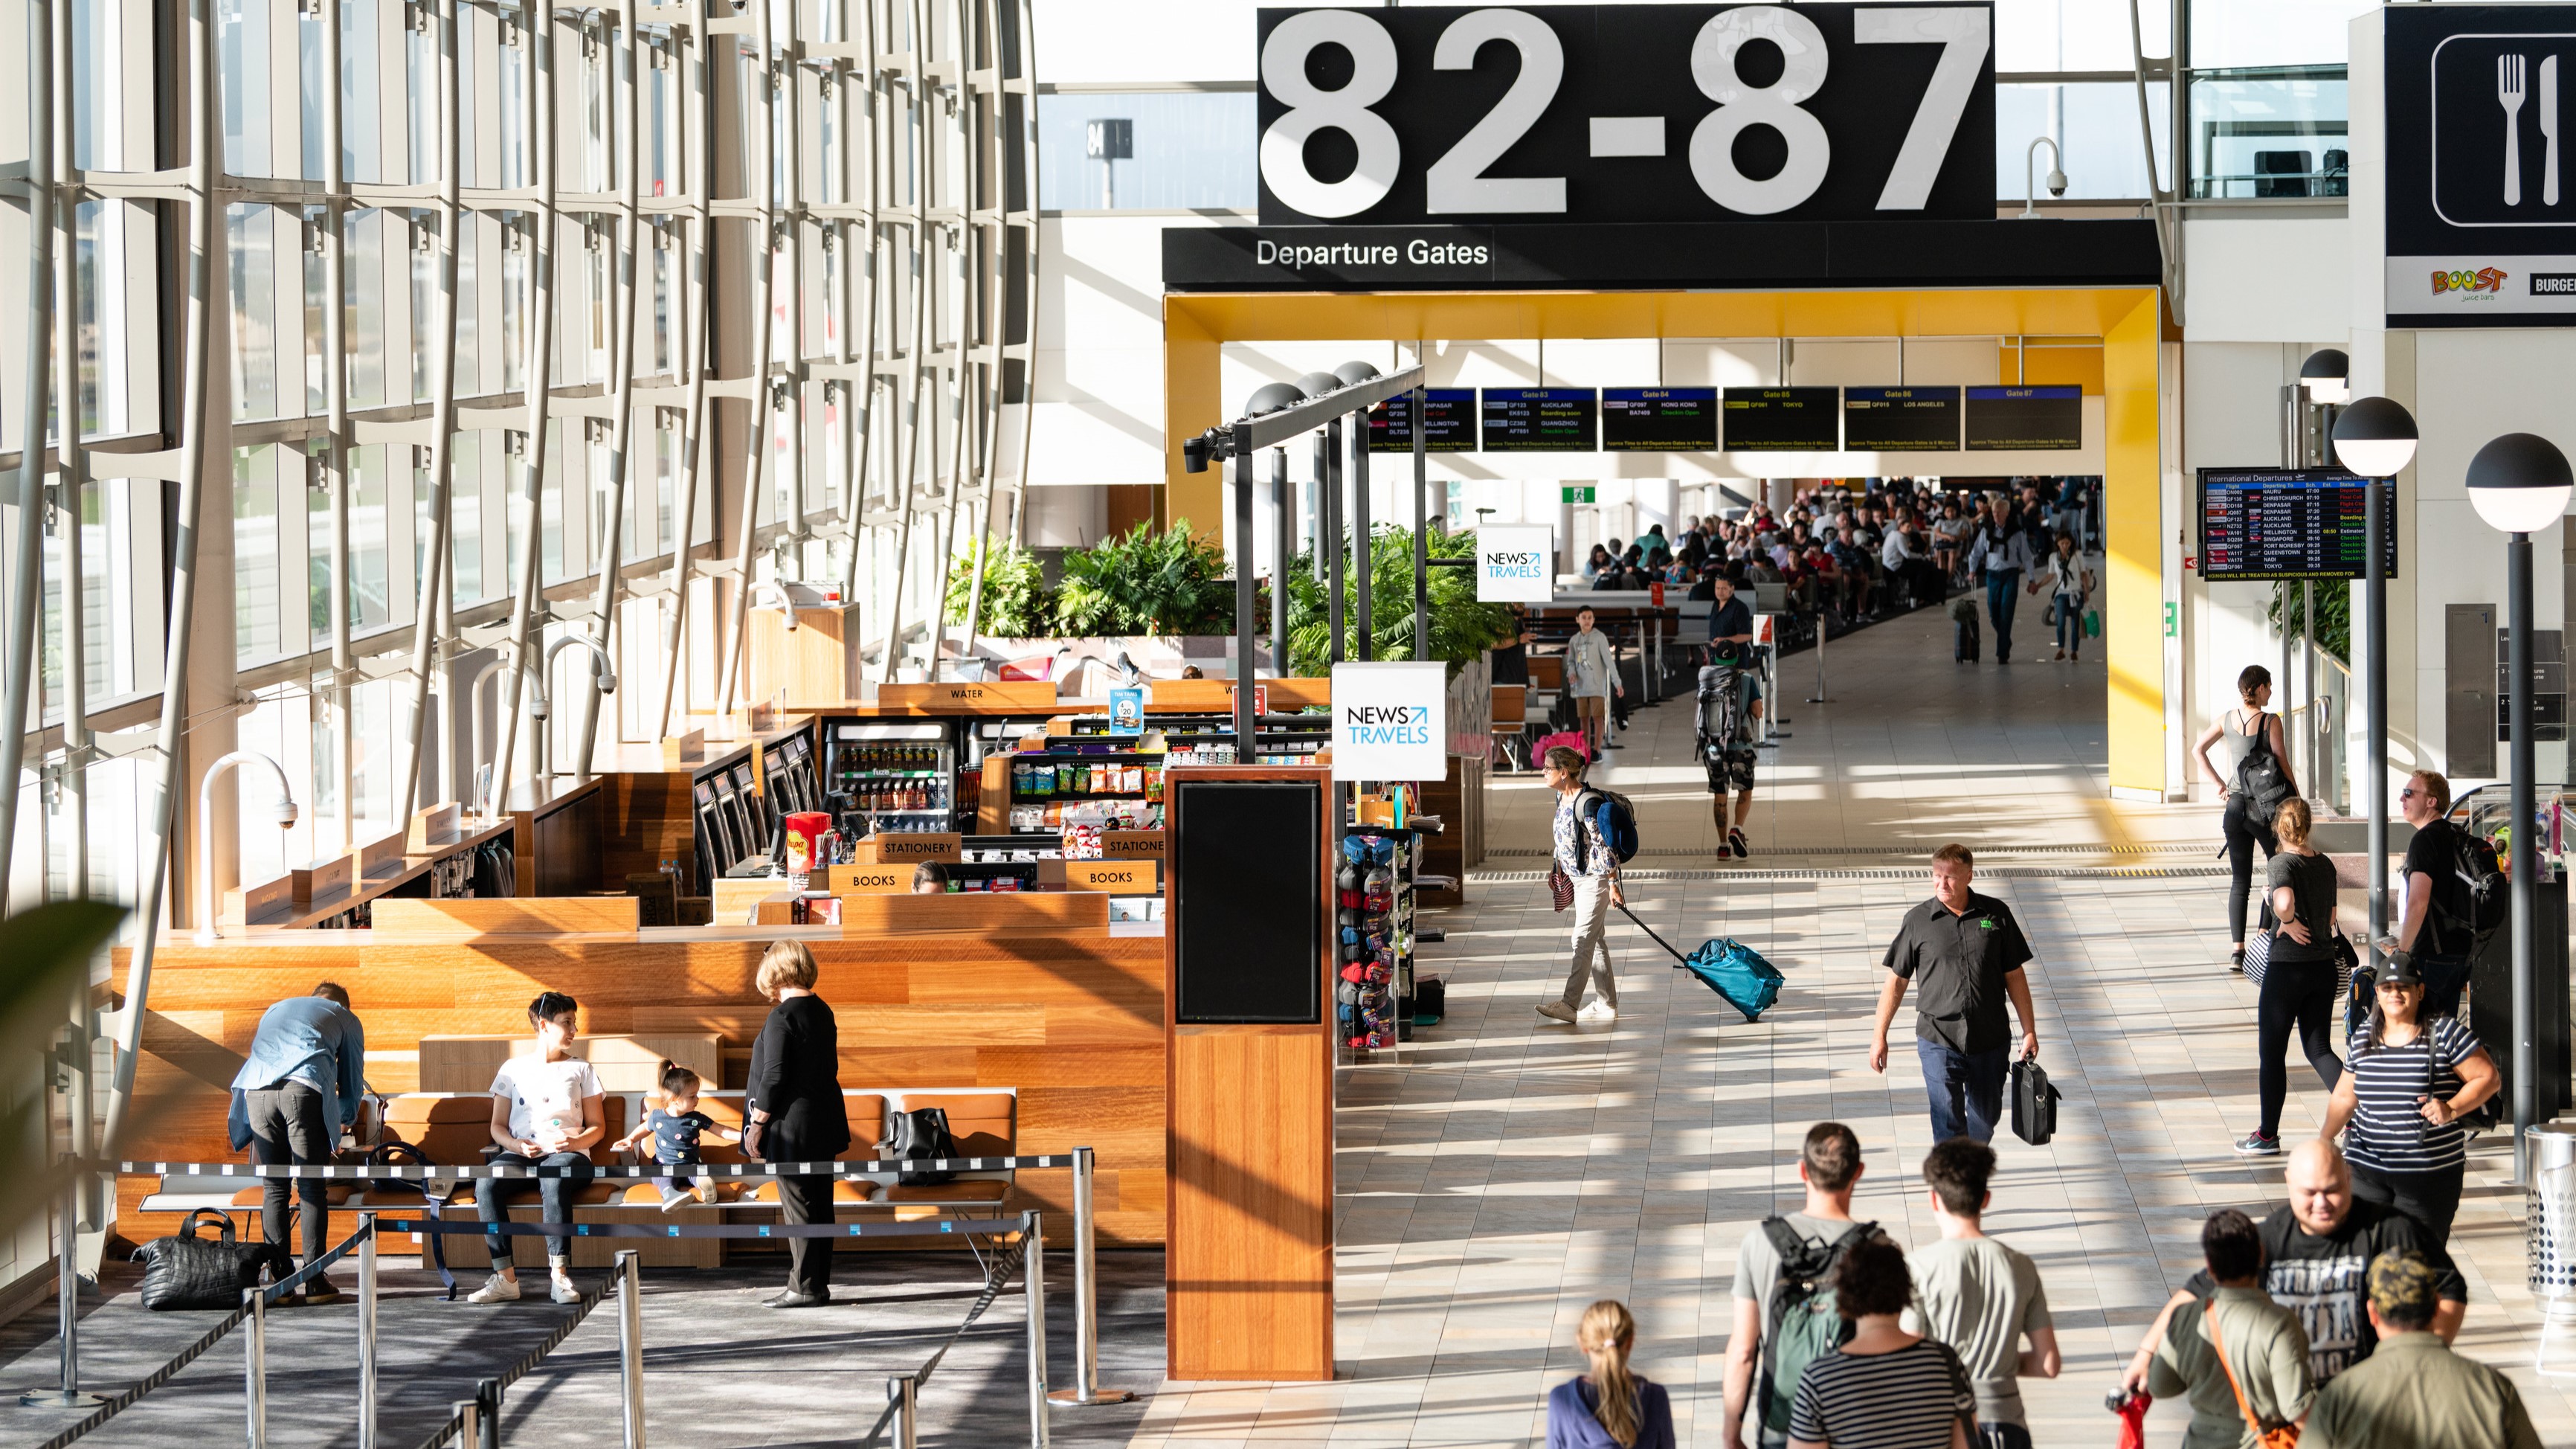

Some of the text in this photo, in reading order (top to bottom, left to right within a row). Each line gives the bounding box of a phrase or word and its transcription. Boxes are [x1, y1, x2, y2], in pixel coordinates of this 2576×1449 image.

[1260, 6, 1990, 218] 82-87
[1258, 240, 1488, 270] Departure Gates
[2432, 267, 2508, 295] BOOST
[2536, 279, 2576, 292] BURGE
[2461, 294, 2479, 302] juice
[1487, 553, 1527, 565] NEWS
[1487, 566, 1541, 578] TRAVELS
[950, 690, 983, 698] WATER
[1347, 707, 1408, 724] NEWS
[1348, 726, 1429, 744] TRAVELS
[788, 839, 805, 849] hupa
[885, 843, 953, 853] STATIONERY
[1110, 841, 1165, 851] STATIONE
[853, 875, 895, 887] BOOKS
[1090, 873, 1133, 883] BOOKS
